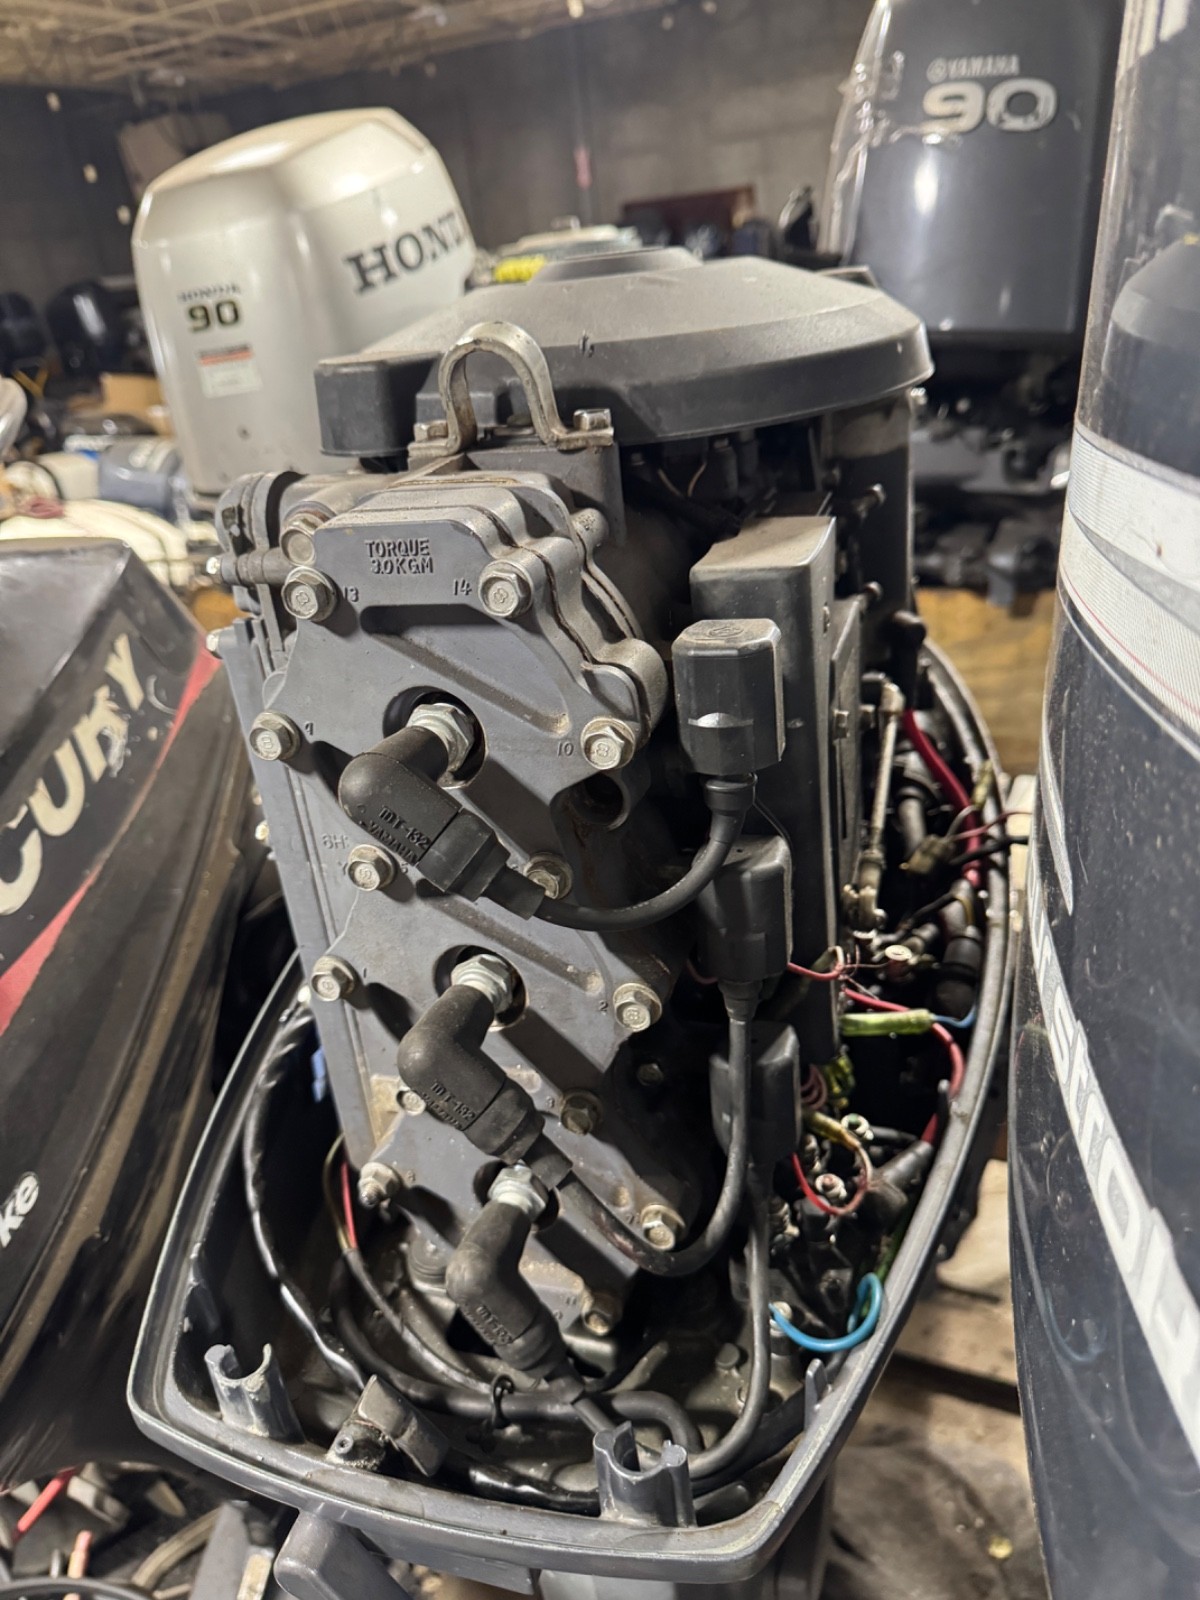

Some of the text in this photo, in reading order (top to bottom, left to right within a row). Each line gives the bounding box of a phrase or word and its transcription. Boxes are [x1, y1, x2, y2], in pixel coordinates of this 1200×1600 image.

[922, 78, 1058, 133] 90
[344, 211, 463, 295] HON
[187, 300, 240, 333] 90
[364, 537, 431, 558] TORQUE
[453, 578, 473, 596] 14
[557, 741, 574, 757] 10
